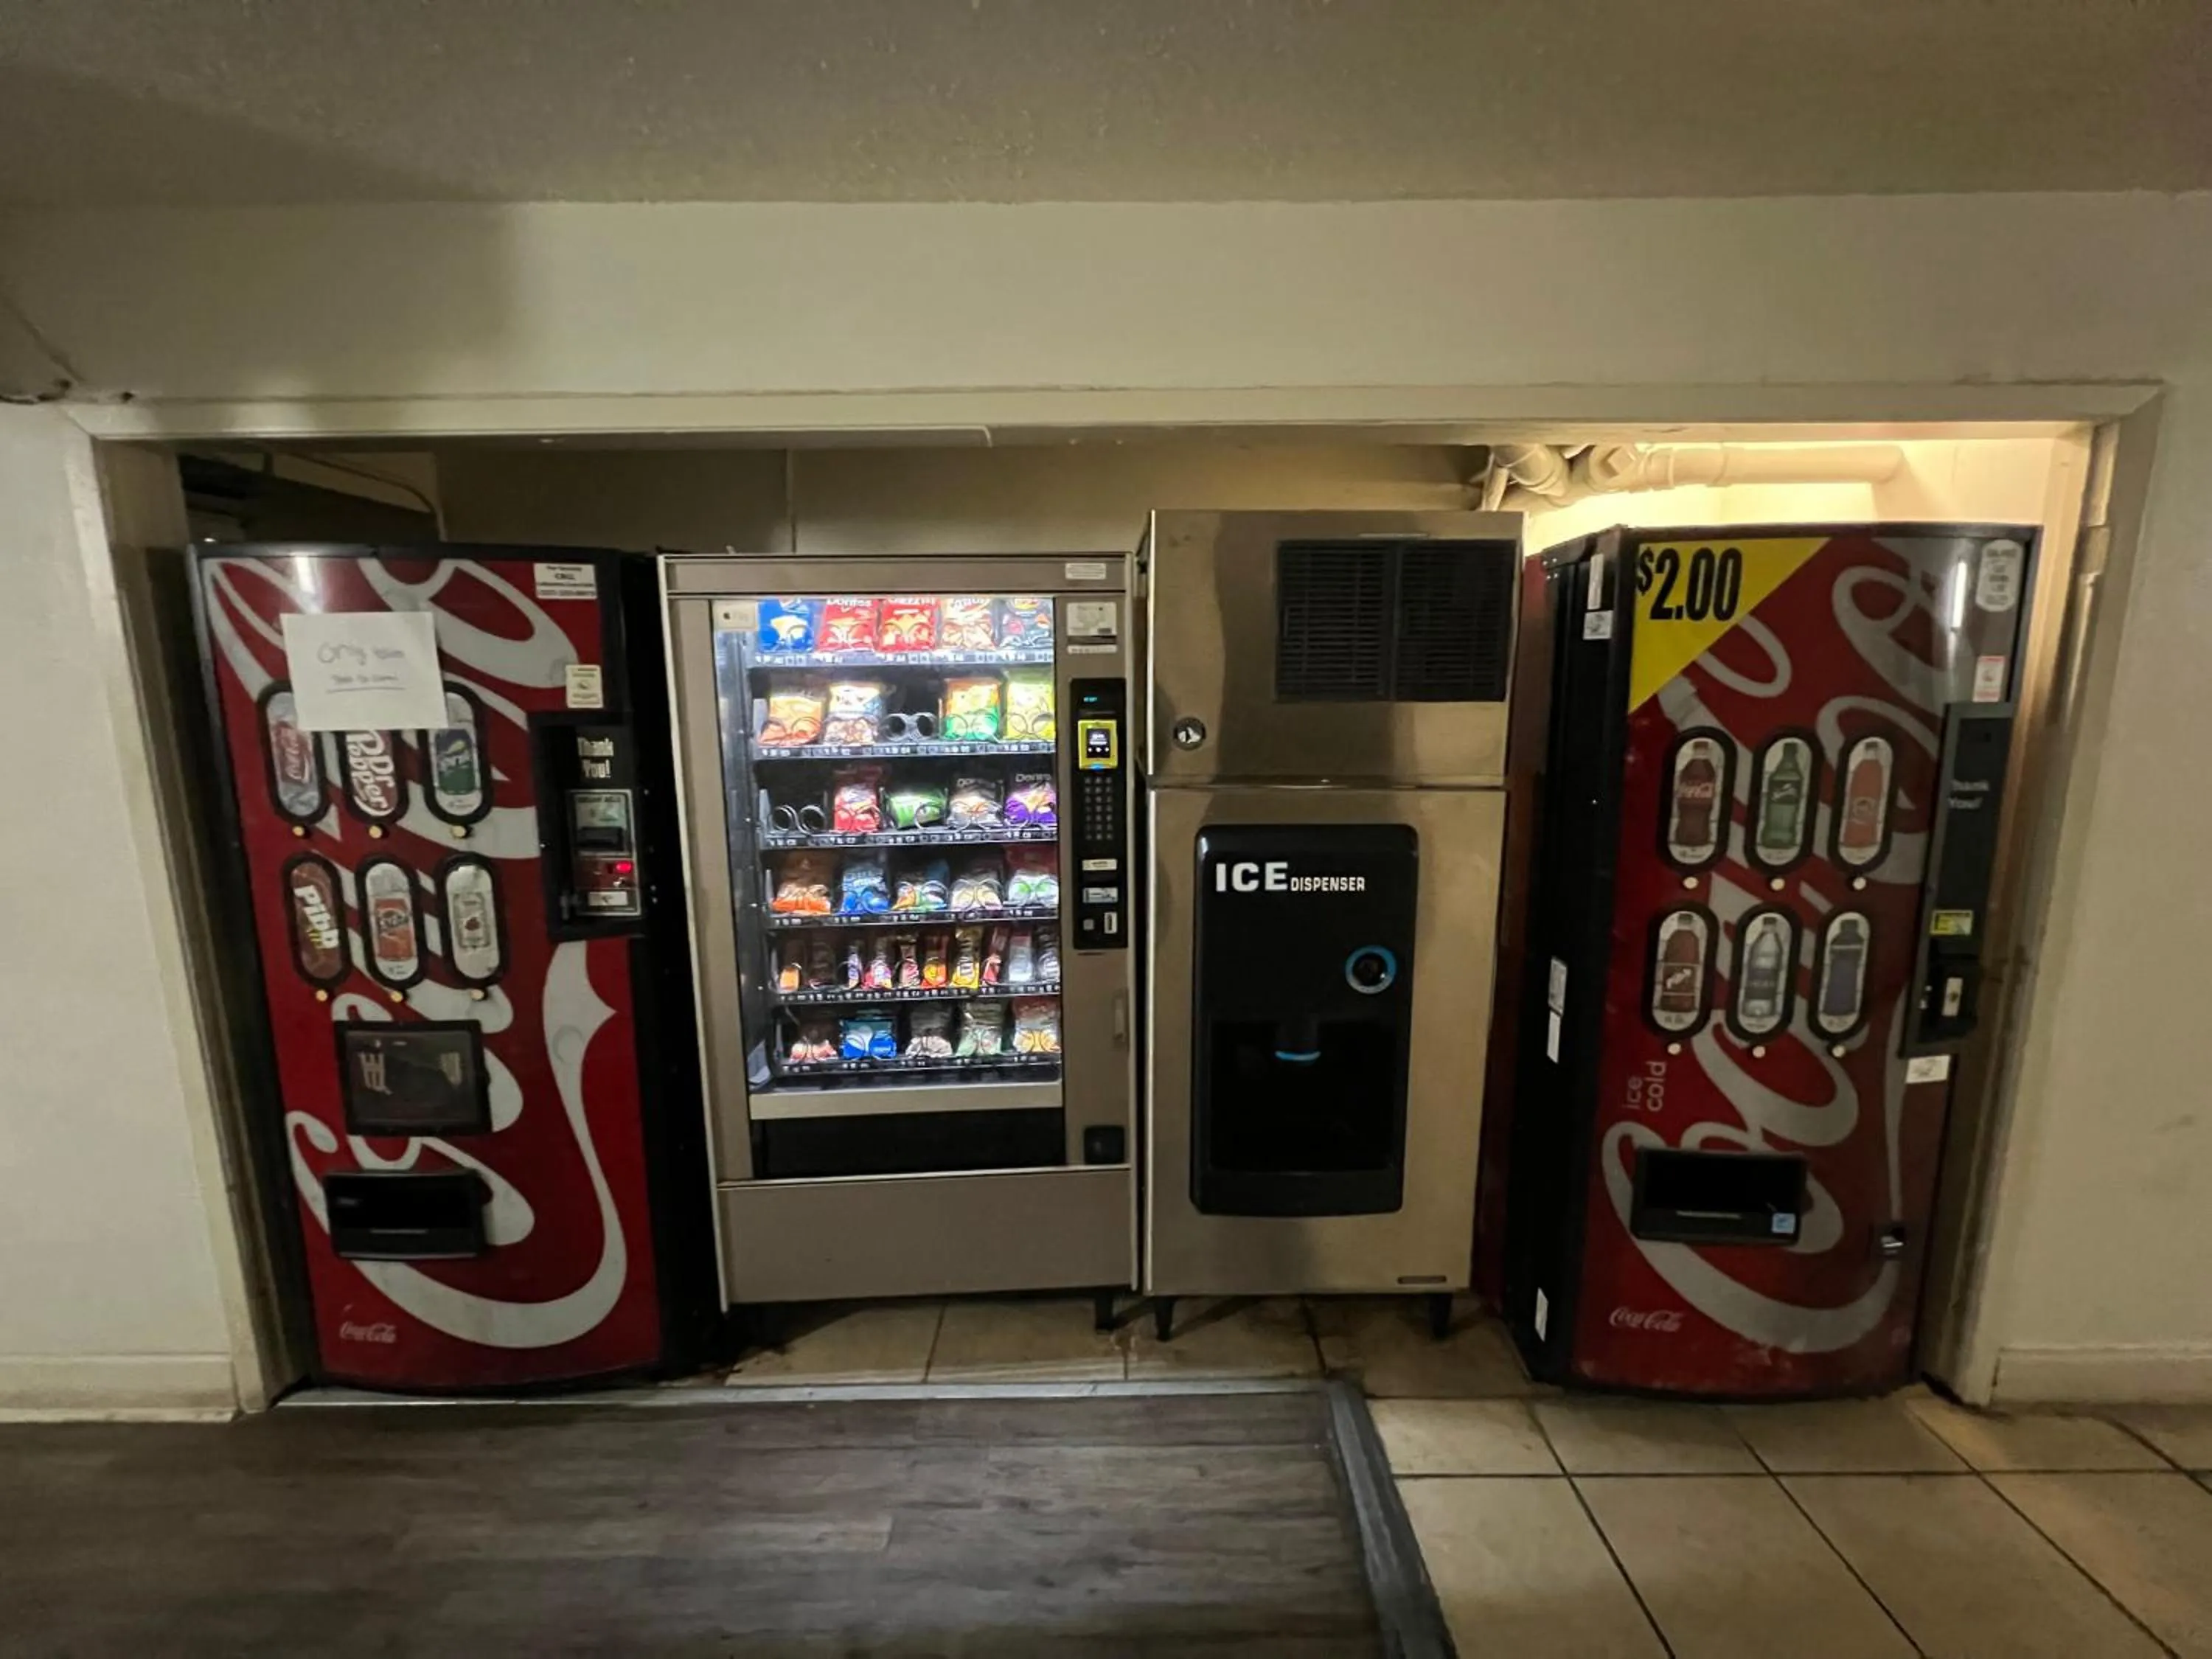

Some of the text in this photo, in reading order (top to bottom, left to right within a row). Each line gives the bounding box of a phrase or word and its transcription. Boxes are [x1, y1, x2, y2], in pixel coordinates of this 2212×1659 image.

[1638, 546, 1743, 622] $2.00
[577, 737, 613, 757] Thank
[370, 754, 396, 788] Dr
[582, 759, 611, 779] You!
[1215, 861, 1366, 892] ICE DISPENSER
[1622, 1076, 1643, 1110] ice
[1645, 1061, 1666, 1112] cold
